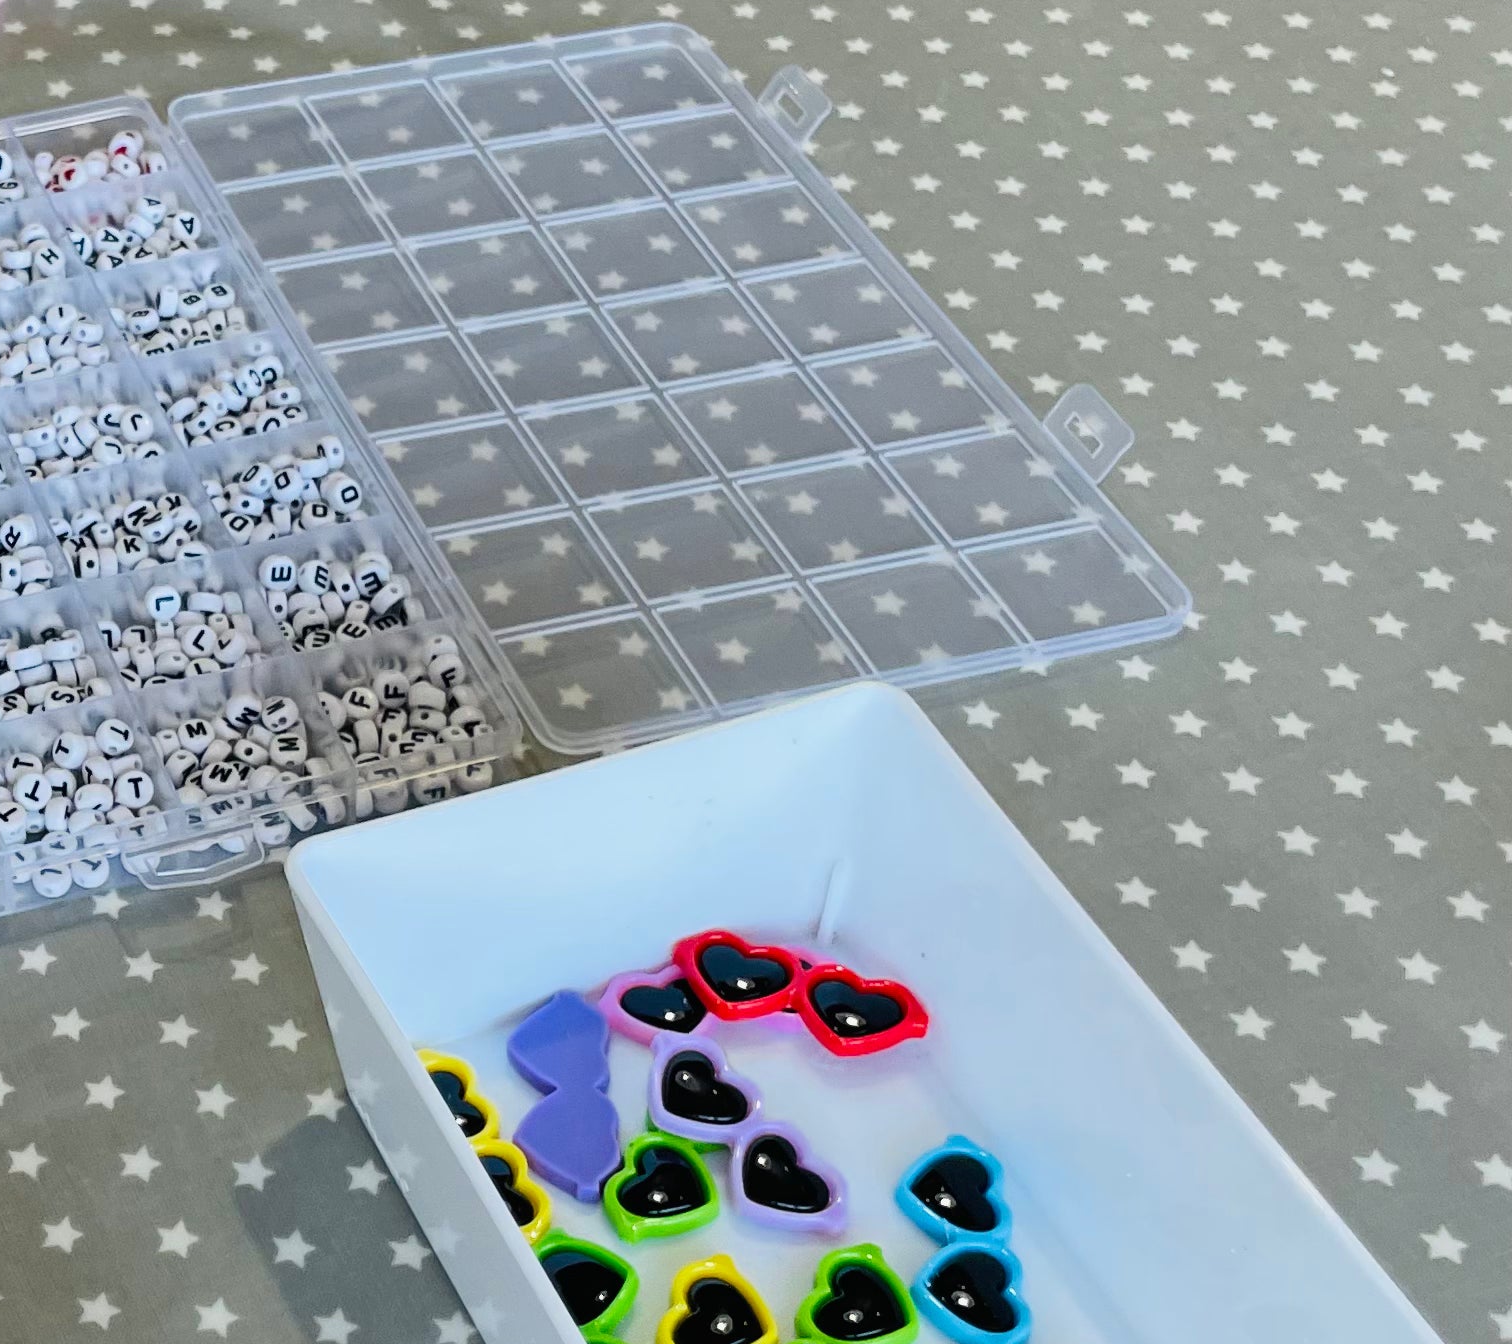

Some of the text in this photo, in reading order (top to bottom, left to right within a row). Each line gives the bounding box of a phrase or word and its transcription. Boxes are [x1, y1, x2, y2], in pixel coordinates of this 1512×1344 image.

[180, 217, 195, 235] A
[101, 229, 120, 243] A
[40, 248, 59, 265] H
[134, 246, 153, 259] A
[107, 255, 124, 269] A
[4, 525, 21, 550] R
[123, 537, 141, 554] K
[155, 596, 174, 612] L
[50, 690, 75, 704] S
[348, 690, 371, 710] F
[185, 721, 208, 739] M
[54, 738, 70, 755] T
[12, 756, 34, 769] T
[24, 780, 40, 802] T
[127, 776, 143, 799] T
